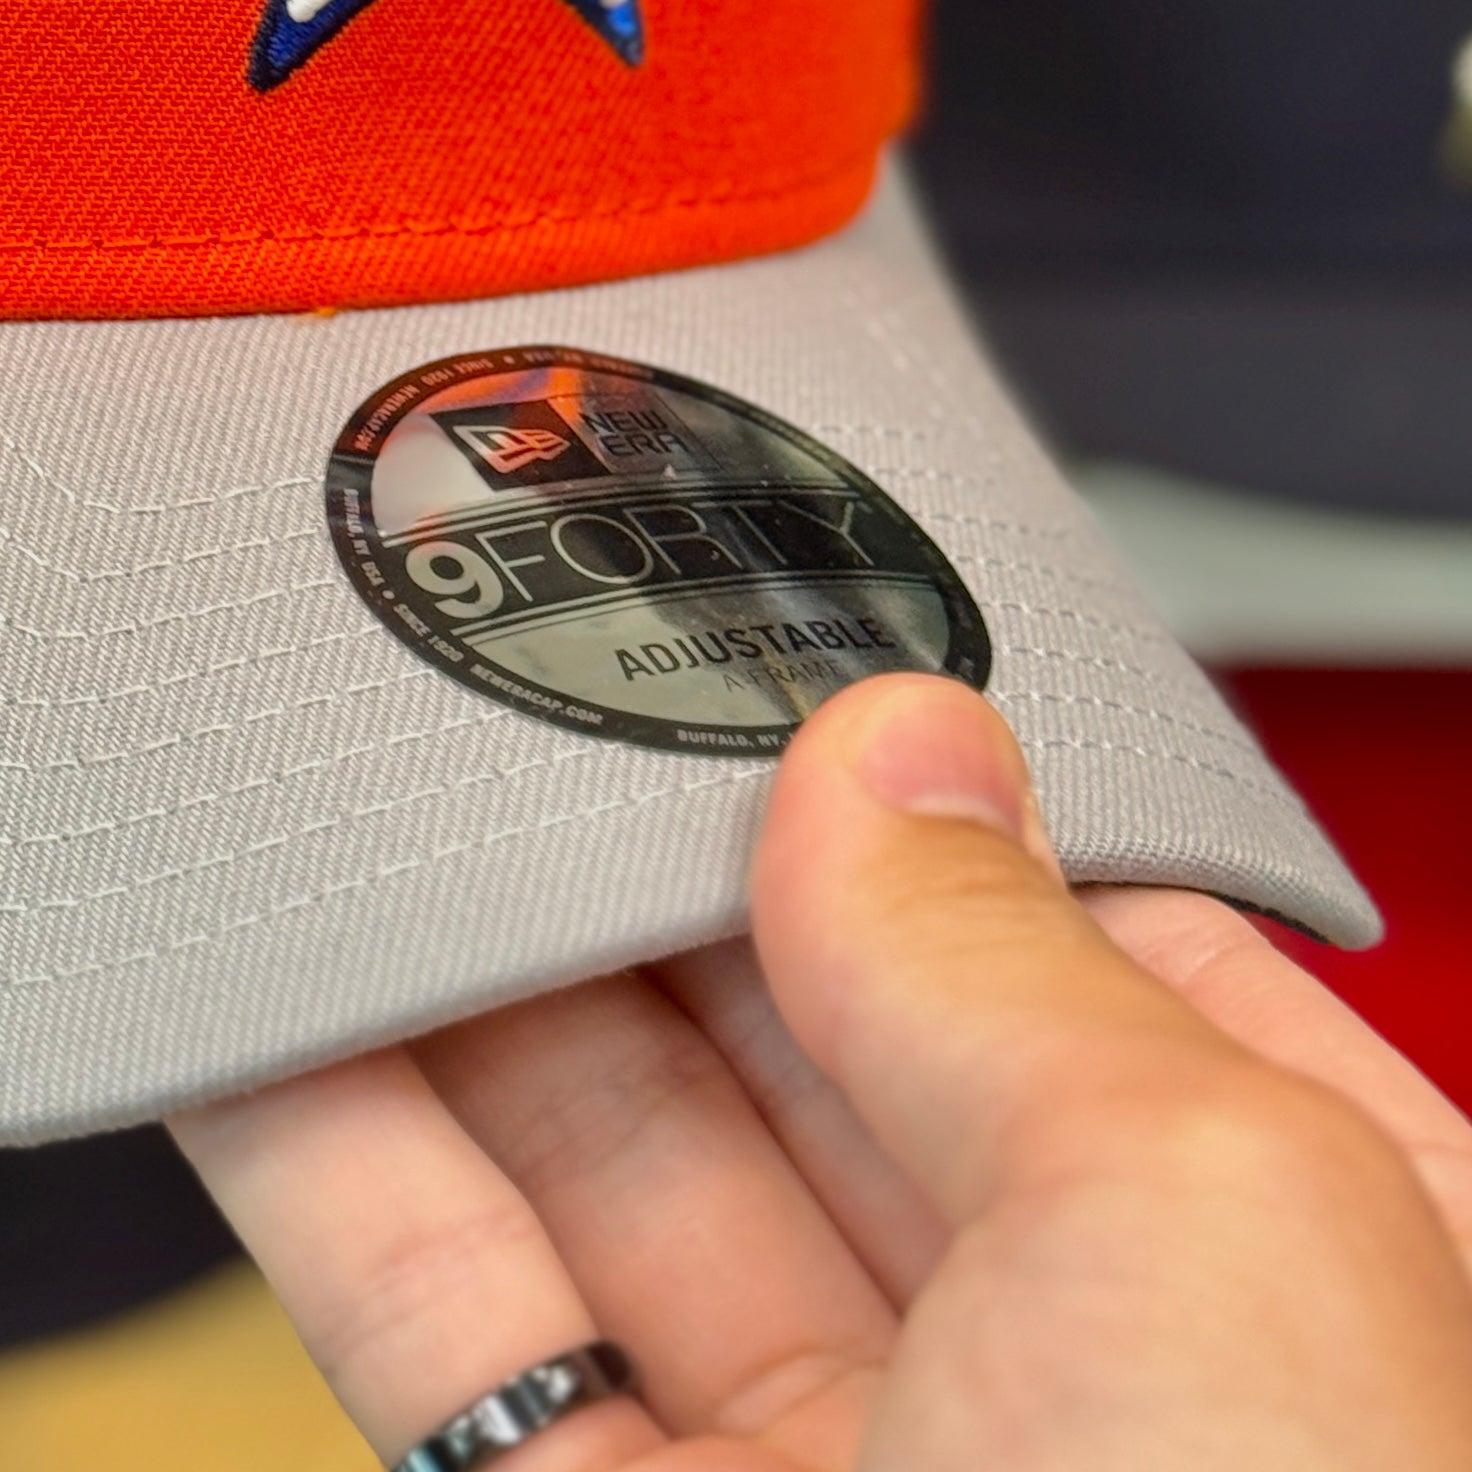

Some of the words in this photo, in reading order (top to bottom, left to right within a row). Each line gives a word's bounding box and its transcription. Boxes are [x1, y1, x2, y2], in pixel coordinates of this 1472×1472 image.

[578, 409, 670, 435] NEW
[599, 431, 692, 457] ERA
[404, 496, 876, 620] 9FORTY
[613, 617, 898, 682] ADJUSTABLE
